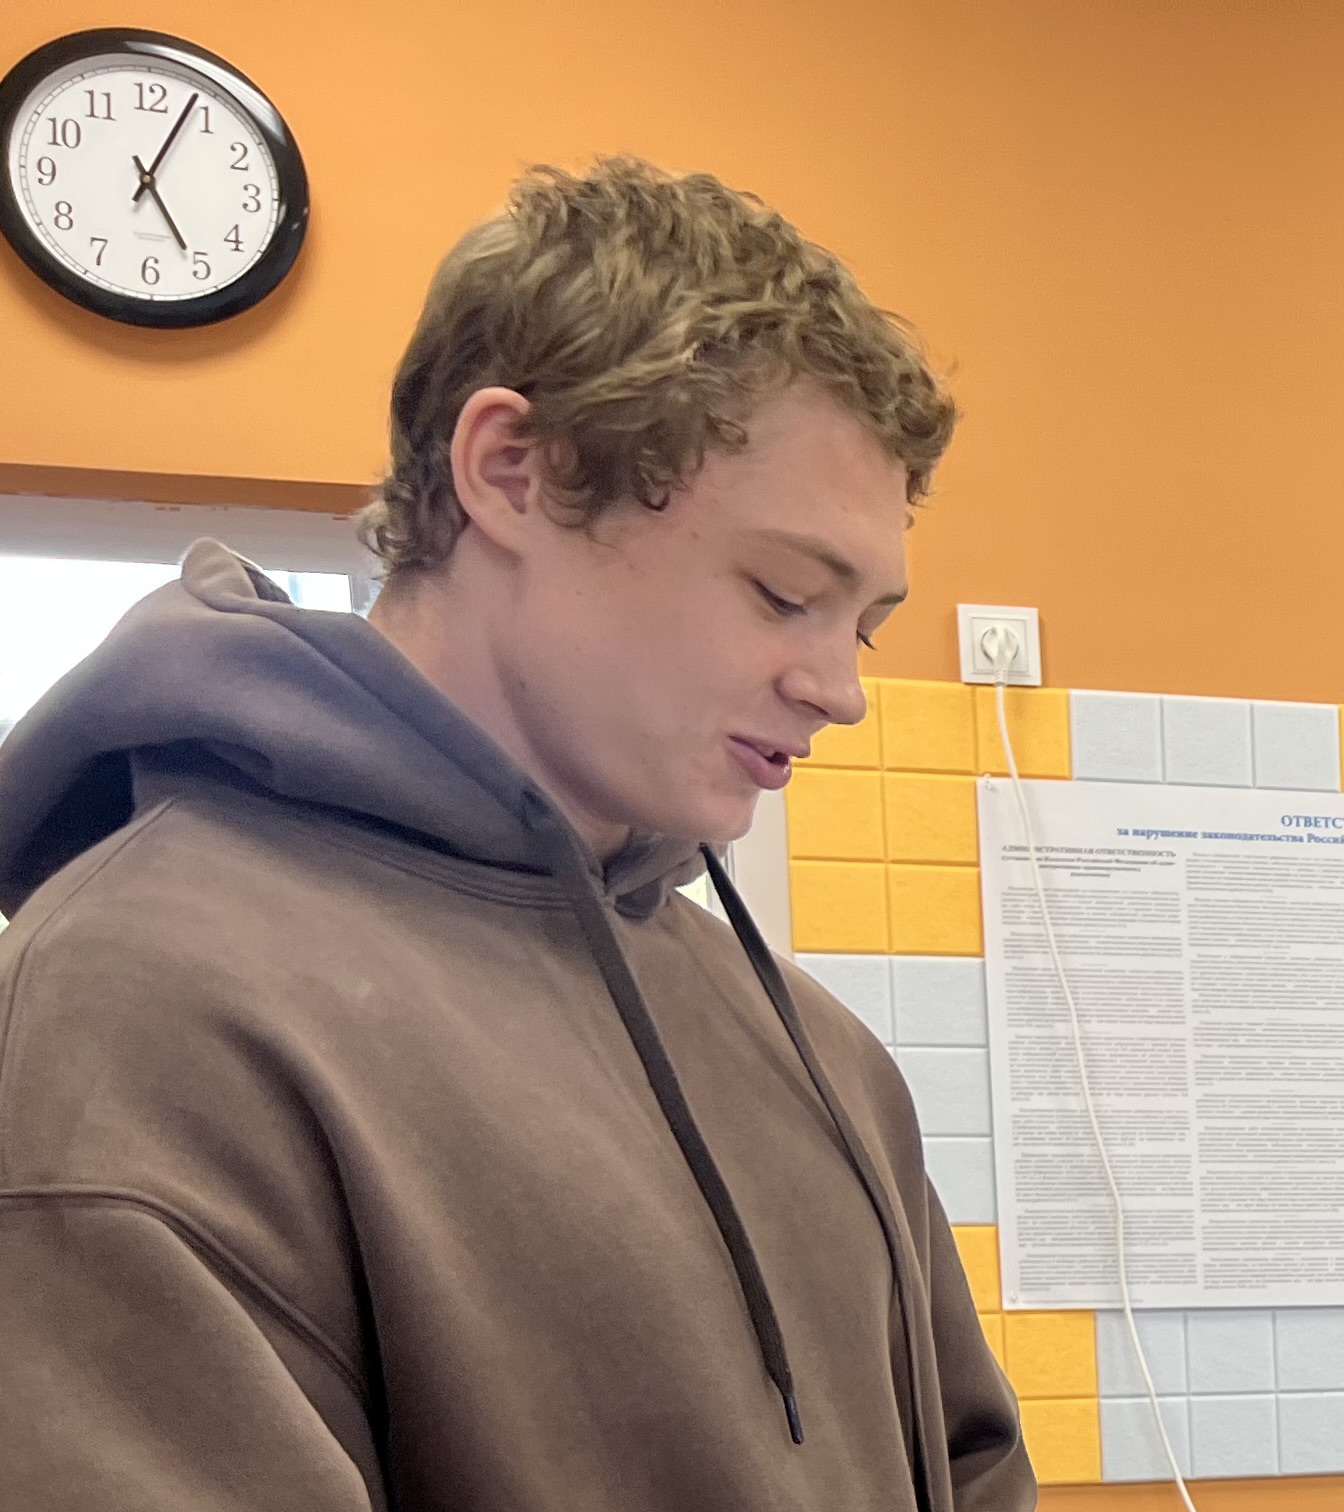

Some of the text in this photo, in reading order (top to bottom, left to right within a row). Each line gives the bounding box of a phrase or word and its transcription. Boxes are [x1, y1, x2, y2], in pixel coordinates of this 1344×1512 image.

[84, 89, 117, 121] 11
[133, 82, 169, 114] 12
[47, 117, 81, 149] 10
[199, 106, 214, 134] 1
[36, 156, 57, 185] 9
[229, 142, 249, 171] 2
[242, 183, 261, 213] 3
[53, 200, 73, 230] 8
[90, 236, 108, 266] 7
[223, 224, 244, 252] 4
[140, 256, 161, 285] 6
[192, 250, 212, 280] 5
[1132, 828, 1198, 841] нарушение
